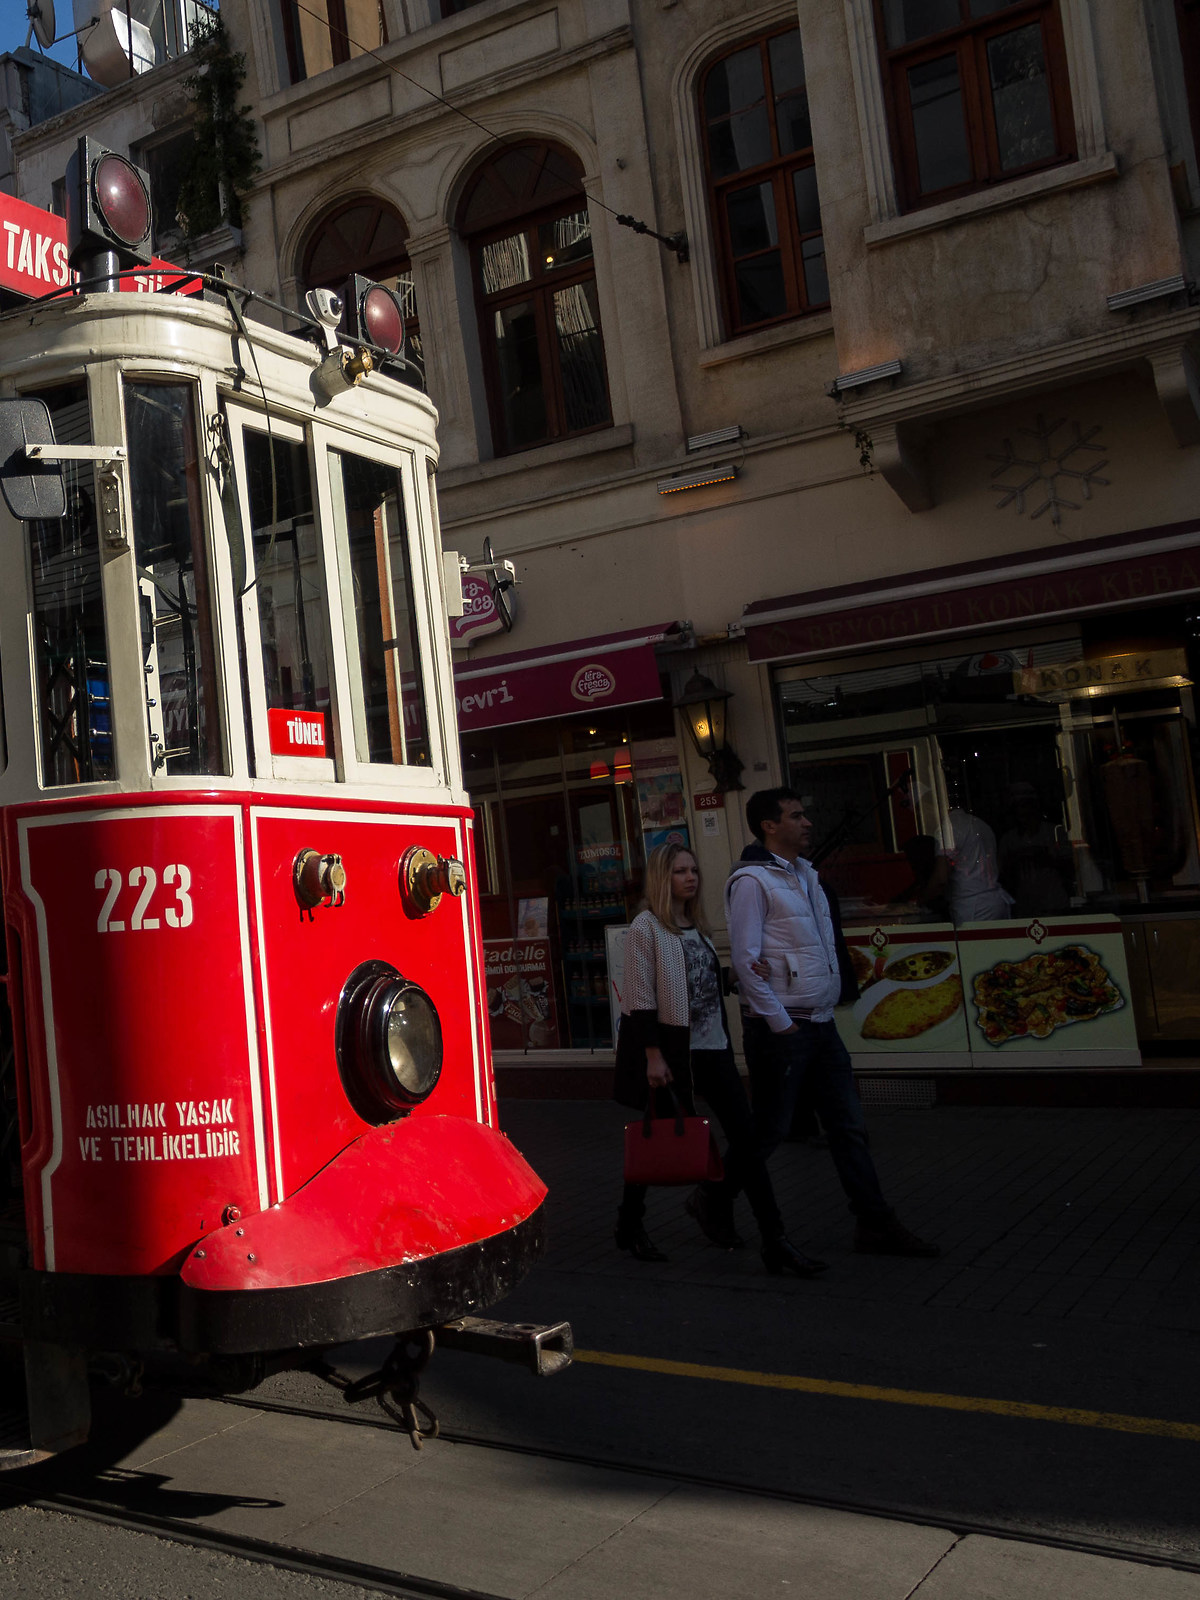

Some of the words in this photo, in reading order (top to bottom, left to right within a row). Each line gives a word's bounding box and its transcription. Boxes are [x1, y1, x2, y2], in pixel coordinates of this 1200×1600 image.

[967, 578, 1089, 623] KONAK
[1041, 658, 1151, 687] KONAK
[287, 717, 324, 746] TÜNEL
[700, 796, 718, 806] 255
[94, 864, 194, 933] 223
[86, 1102, 167, 1128] ASILMAK
[175, 1098, 234, 1127] YASAK
[78, 1136, 103, 1161] VE
[111, 1128, 240, 1162] TEHLİKELİDİR
